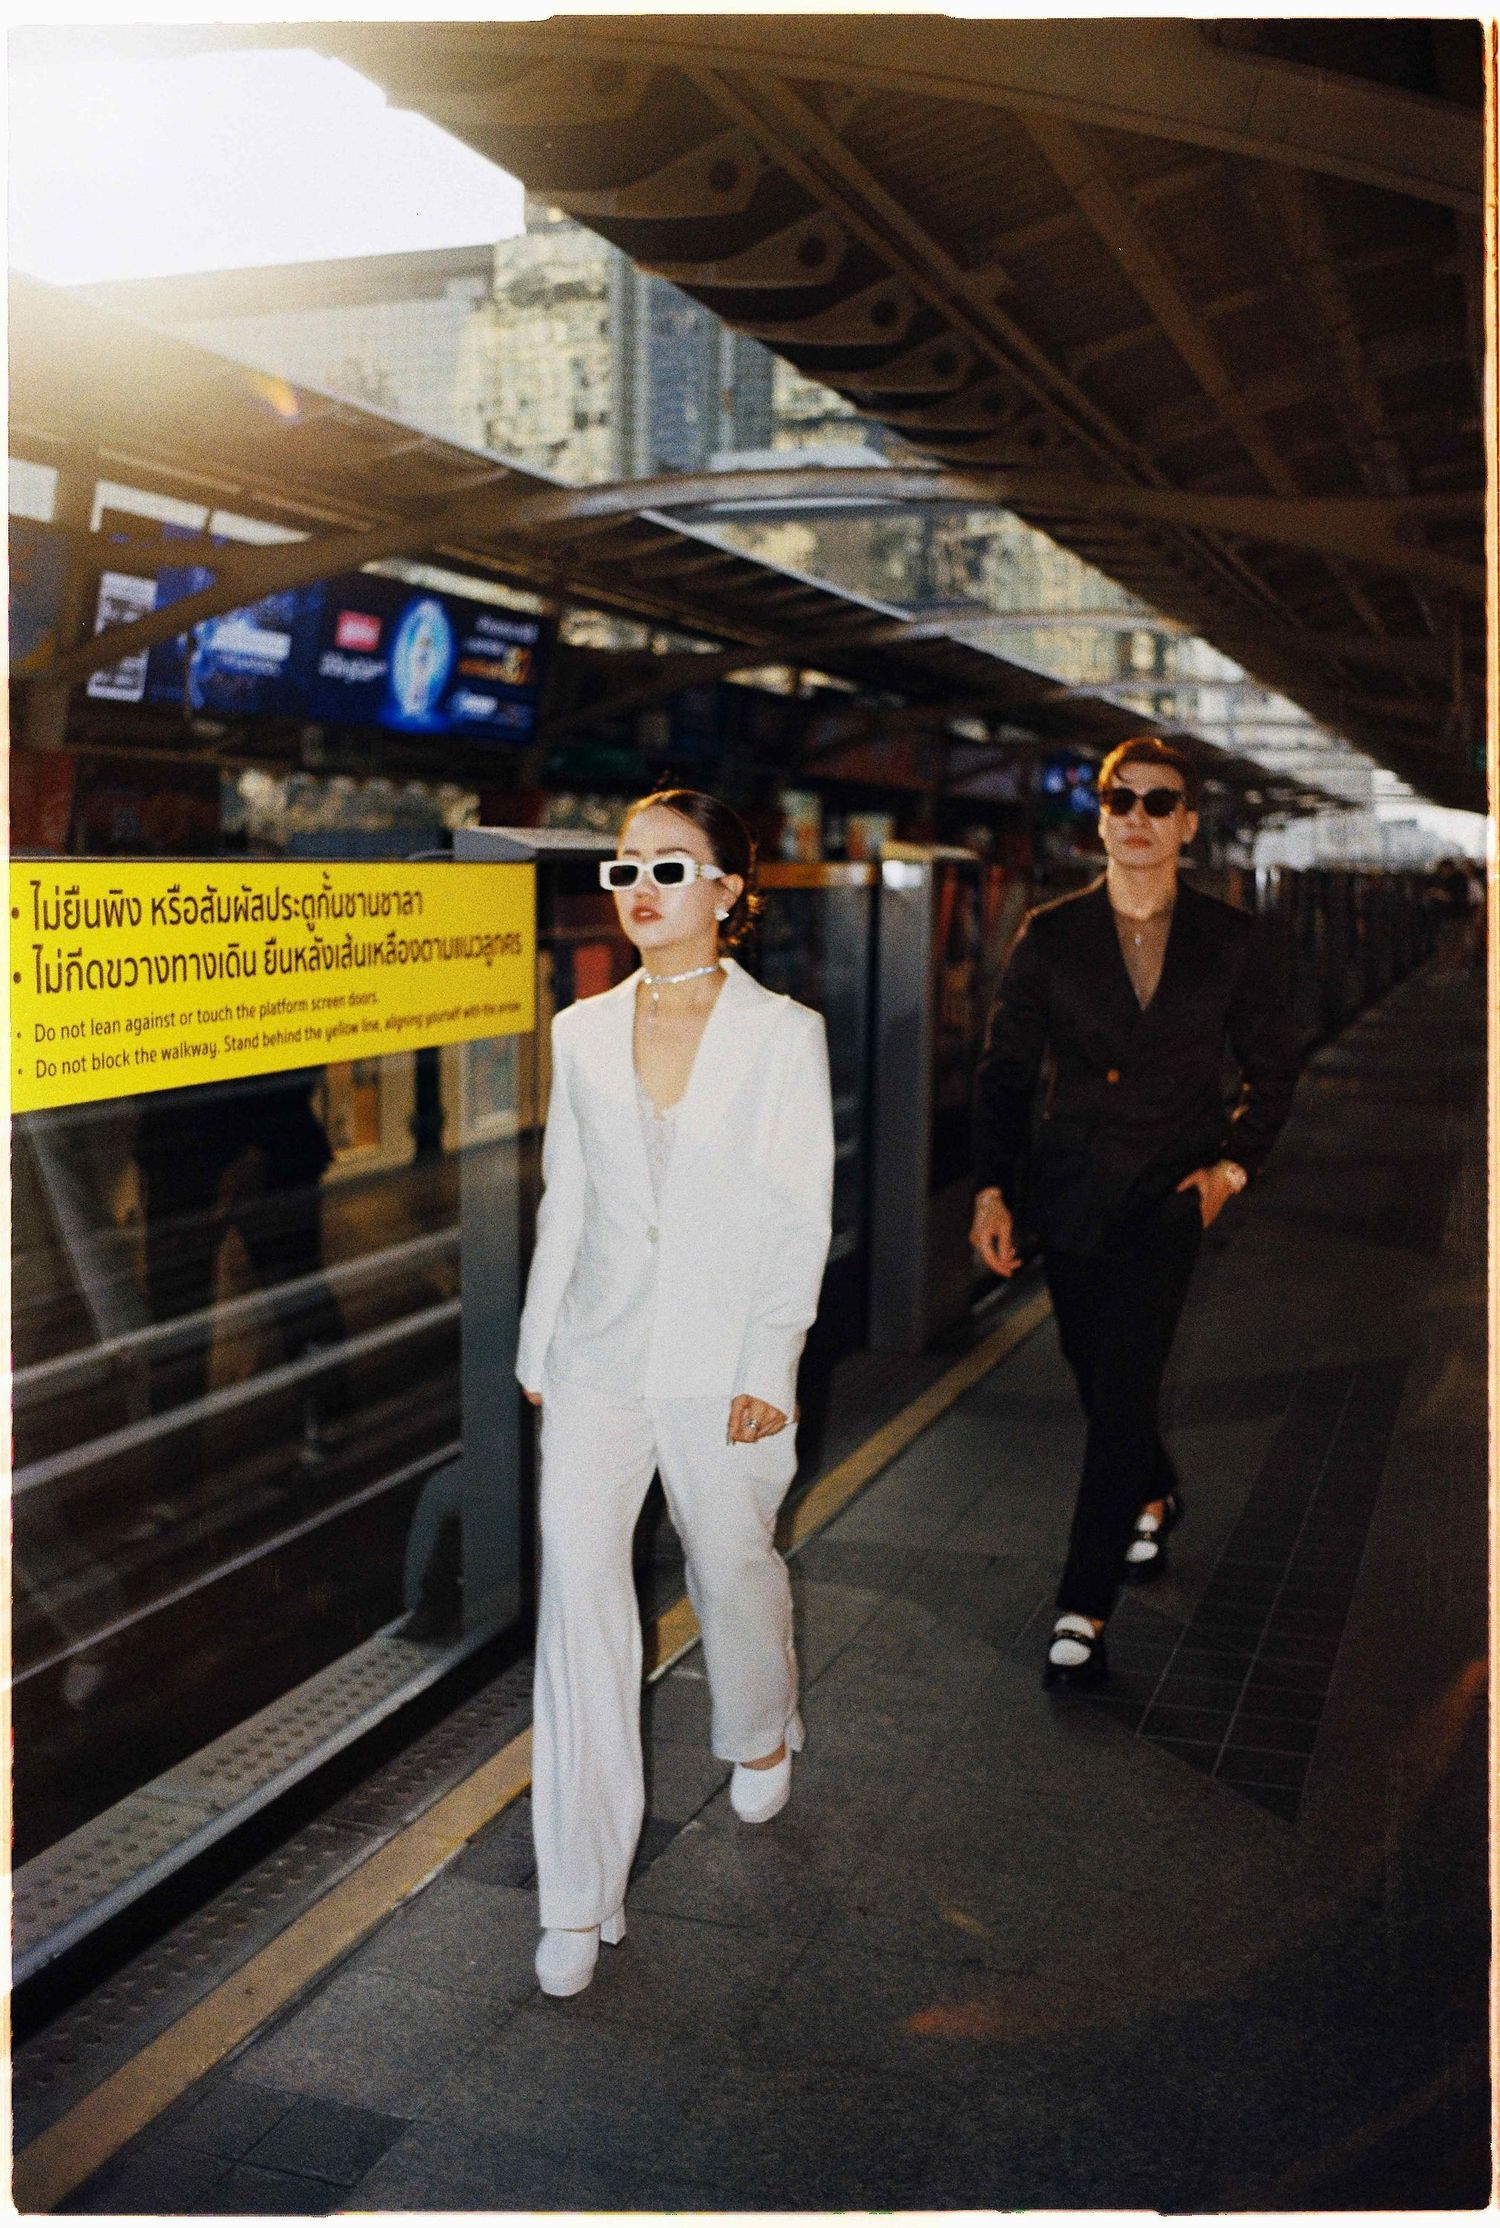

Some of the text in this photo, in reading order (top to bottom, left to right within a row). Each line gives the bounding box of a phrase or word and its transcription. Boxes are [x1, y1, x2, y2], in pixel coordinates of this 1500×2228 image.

[30, 871, 423, 932] ไม่ยืนพิง หรือสัมผัสประตูกั้นชานชาลา
[32, 943, 257, 995] ไม่กีดขวางทางเดิน
[34, 1023, 56, 1043] Do
[61, 1021, 86, 1040] not
[90, 1017, 121, 1036] lean
[125, 1011, 176, 1036] against
[179, 1012, 193, 1026] or
[197, 1004, 233, 1024] touch
[236, 1003, 256, 1020] the
[259, 997, 308, 1022] platform
[311, 994, 346, 1011] screen
[35, 1059, 57, 1079] Do
[61, 1056, 87, 1075] not
[92, 1049, 130, 1072] block
[134, 1045, 157, 1065] the
[161, 1039, 220, 1064] walkway.
[224, 1033, 259, 1053] Stand
[262, 1029, 301, 1048] behind
[304, 1025, 322, 1041] the
[325, 1019, 359, 1043] yellow
